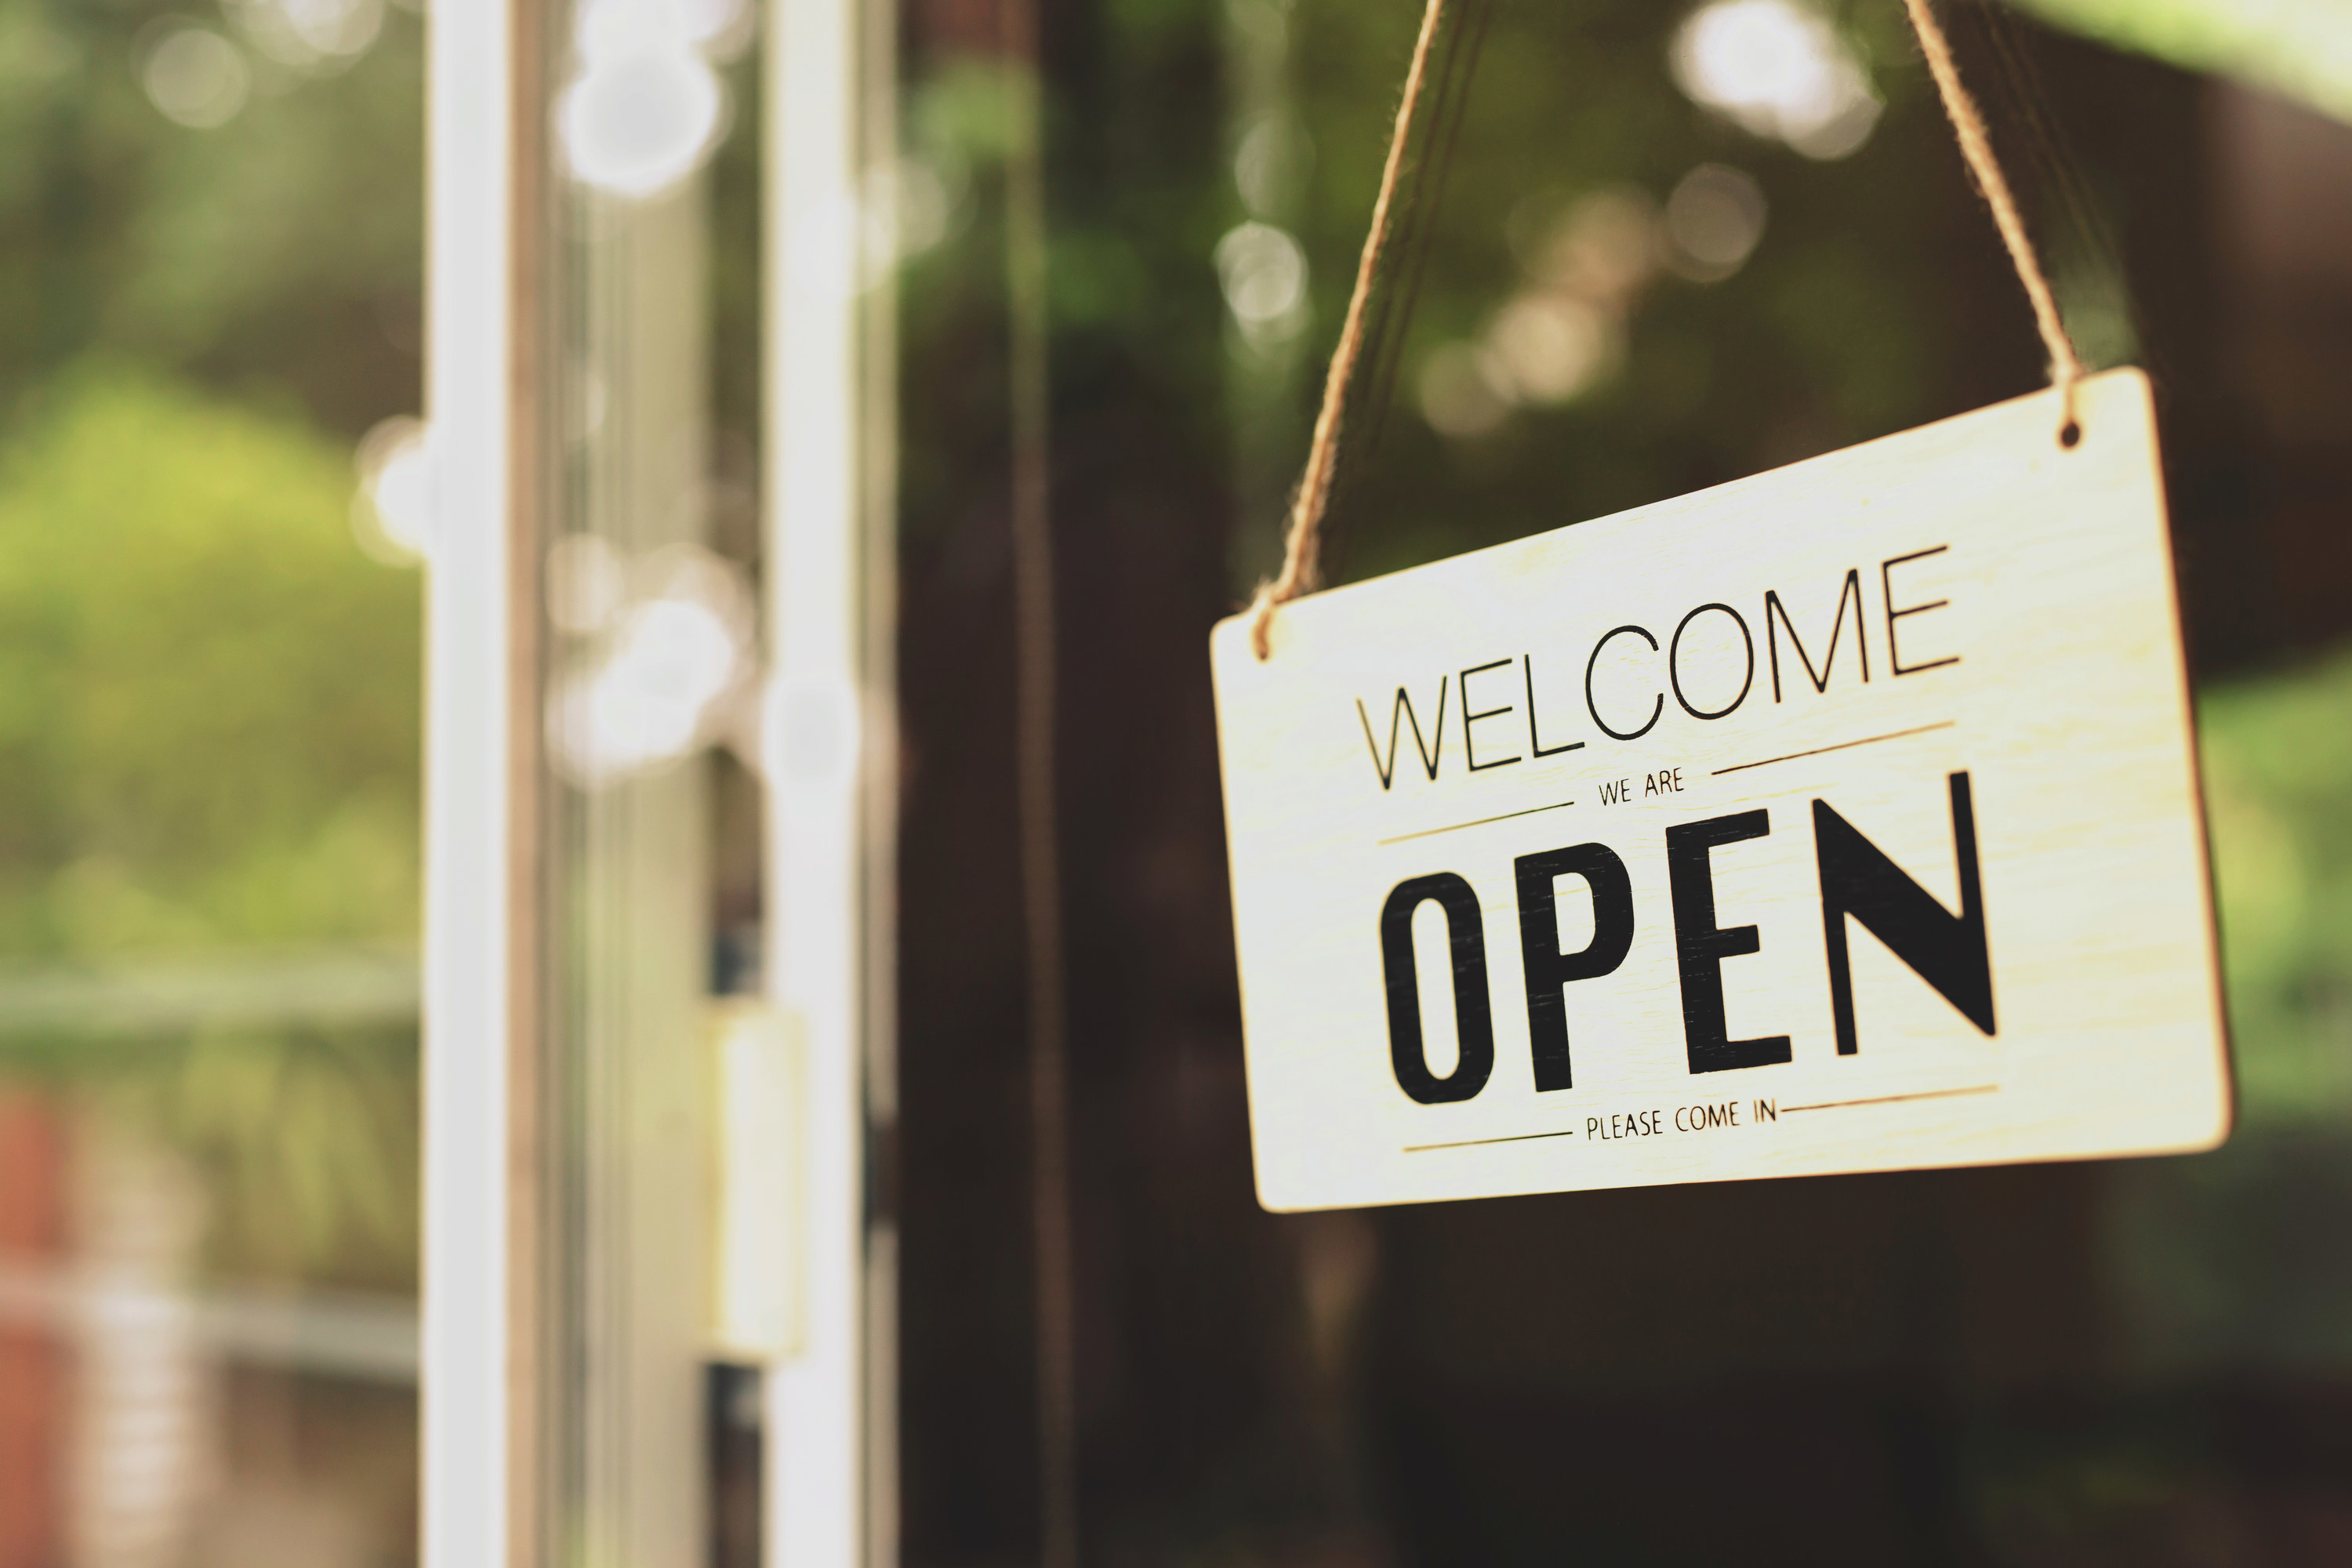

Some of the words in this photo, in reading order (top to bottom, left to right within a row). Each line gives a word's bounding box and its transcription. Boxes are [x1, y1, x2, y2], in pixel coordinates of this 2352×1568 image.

[1357, 545, 1961, 790] WELCOME
[1599, 779, 1632, 807] WE
[1645, 767, 1685, 797] ARE
[1380, 771, 1997, 1105] OPEN
[1587, 1110, 1664, 1141] PLEASE
[1675, 1102, 1740, 1132] COME
[1754, 1099, 1776, 1123] IN
